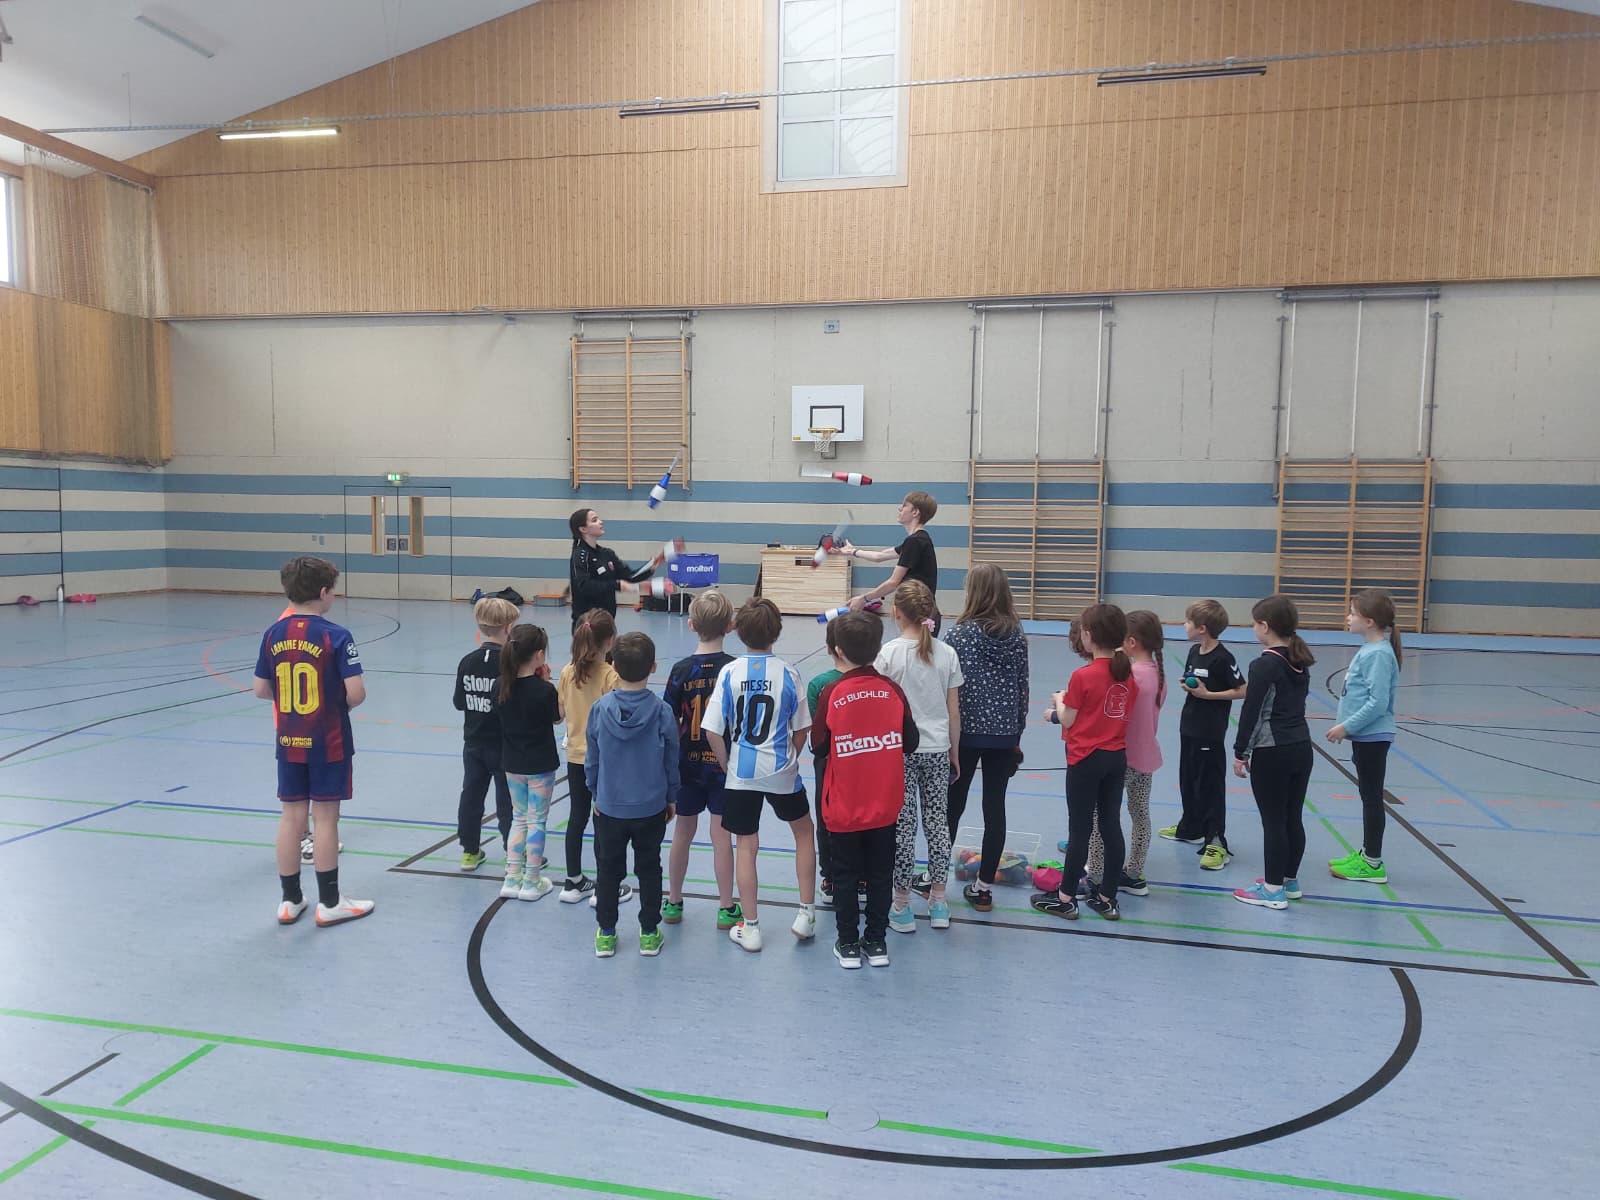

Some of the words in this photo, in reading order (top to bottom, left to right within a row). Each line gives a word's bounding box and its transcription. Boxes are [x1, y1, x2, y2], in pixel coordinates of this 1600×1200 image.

[686, 565, 714, 573] molten
[271, 640, 297, 656] LAMINE
[276, 662, 320, 715] 10
[741, 681, 772, 692] MESSI
[833, 697, 847, 709] FC
[846, 690, 890, 703] BUCHLOE
[732, 694, 775, 745] 10
[835, 731, 903, 756] mensch
